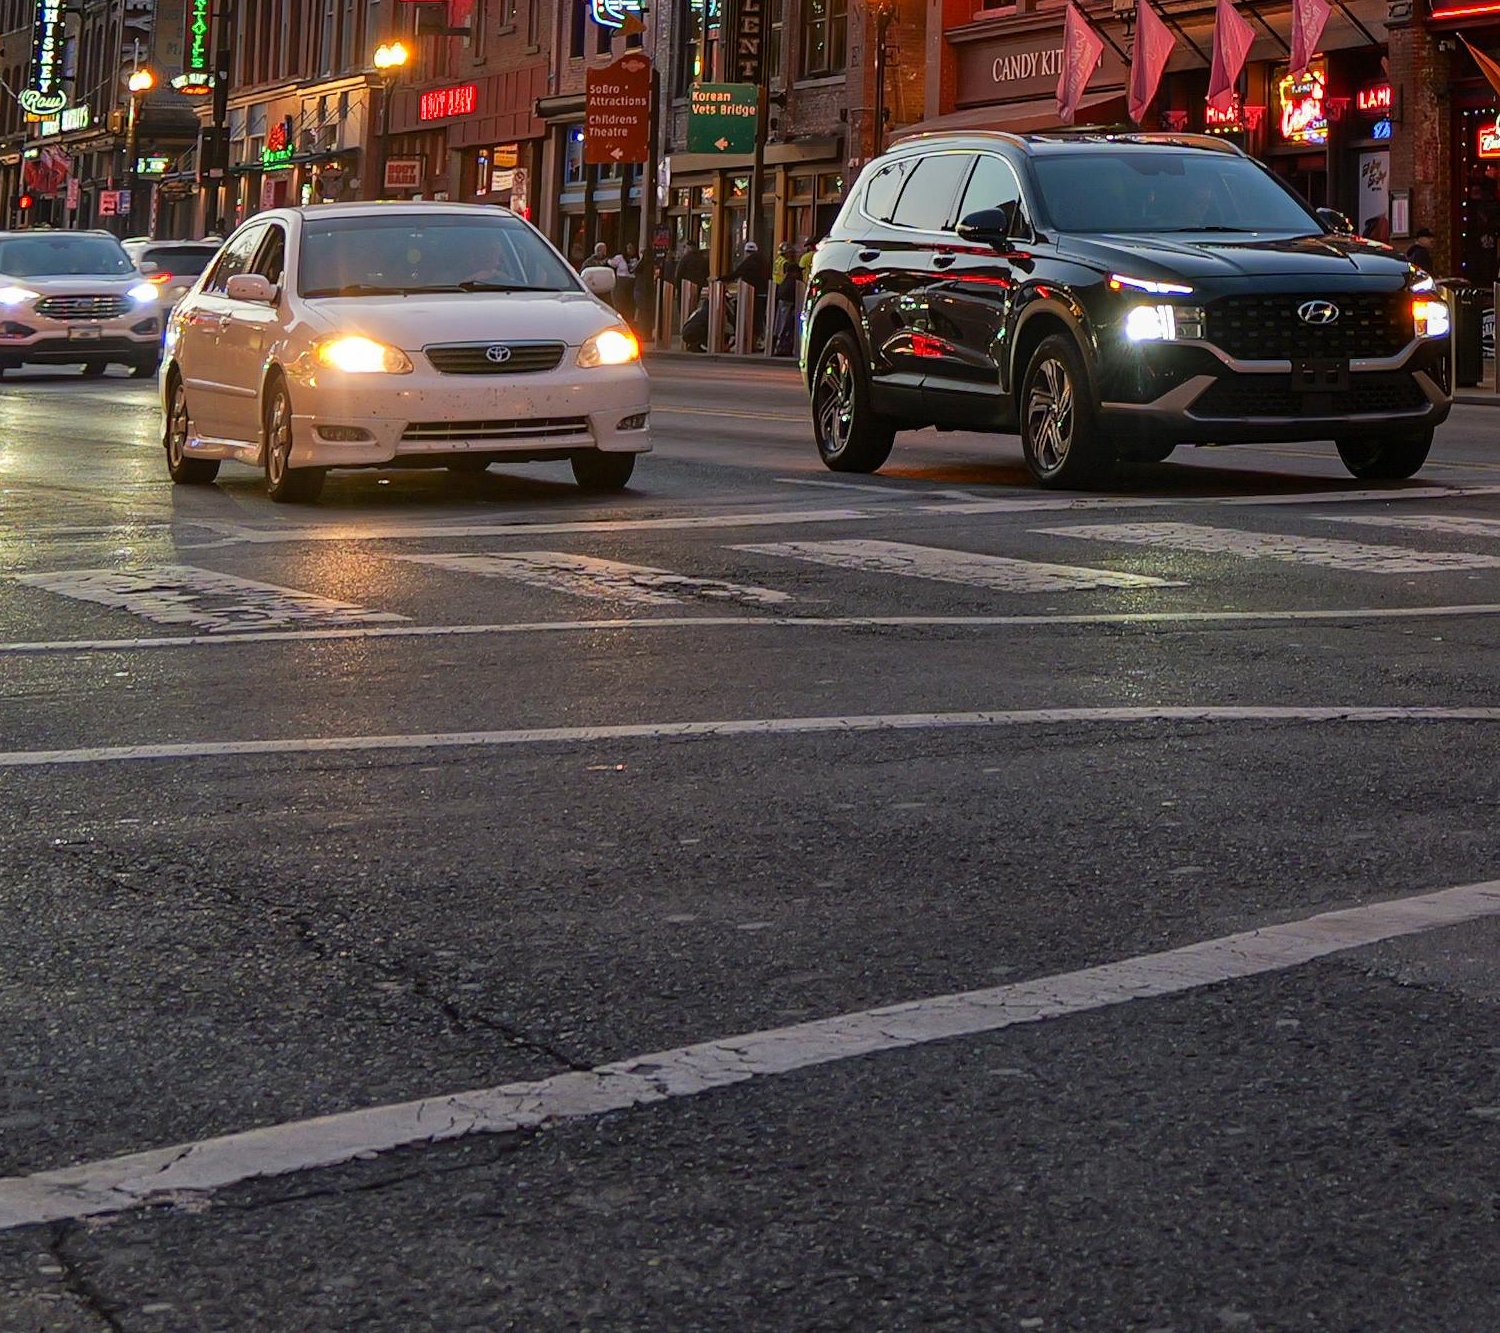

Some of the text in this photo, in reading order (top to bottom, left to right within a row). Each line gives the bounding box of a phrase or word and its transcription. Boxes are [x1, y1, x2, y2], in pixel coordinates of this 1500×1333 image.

[992, 52, 1039, 83] CANDY
[589, 84, 620, 94] SoBro
[26, 91, 62, 113] Row
[590, 96, 647, 107] Attractions
[692, 91, 731, 102] Korean
[1359, 87, 1392, 110] LAM
[692, 104, 756, 117] Vets Bridge
[589, 114, 638, 125] Childrens
[589, 126, 628, 137] Theatre
